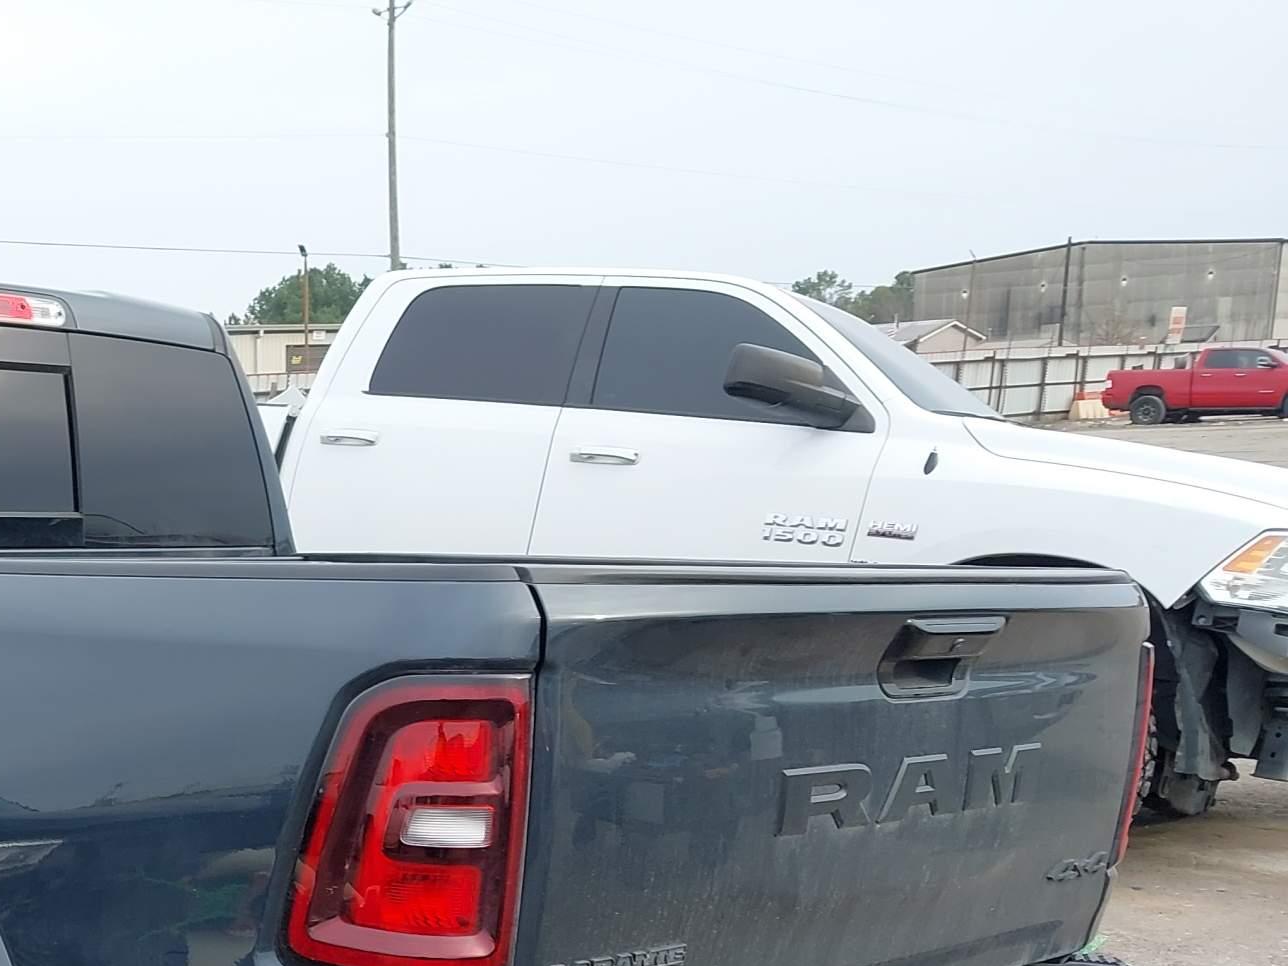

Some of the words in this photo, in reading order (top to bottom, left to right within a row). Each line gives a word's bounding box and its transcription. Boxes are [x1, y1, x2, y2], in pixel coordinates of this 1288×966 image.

[763, 512, 849, 532] RAM
[869, 520, 919, 534] HEMI
[761, 527, 845, 547] 1500
[774, 741, 1042, 837] RAM
